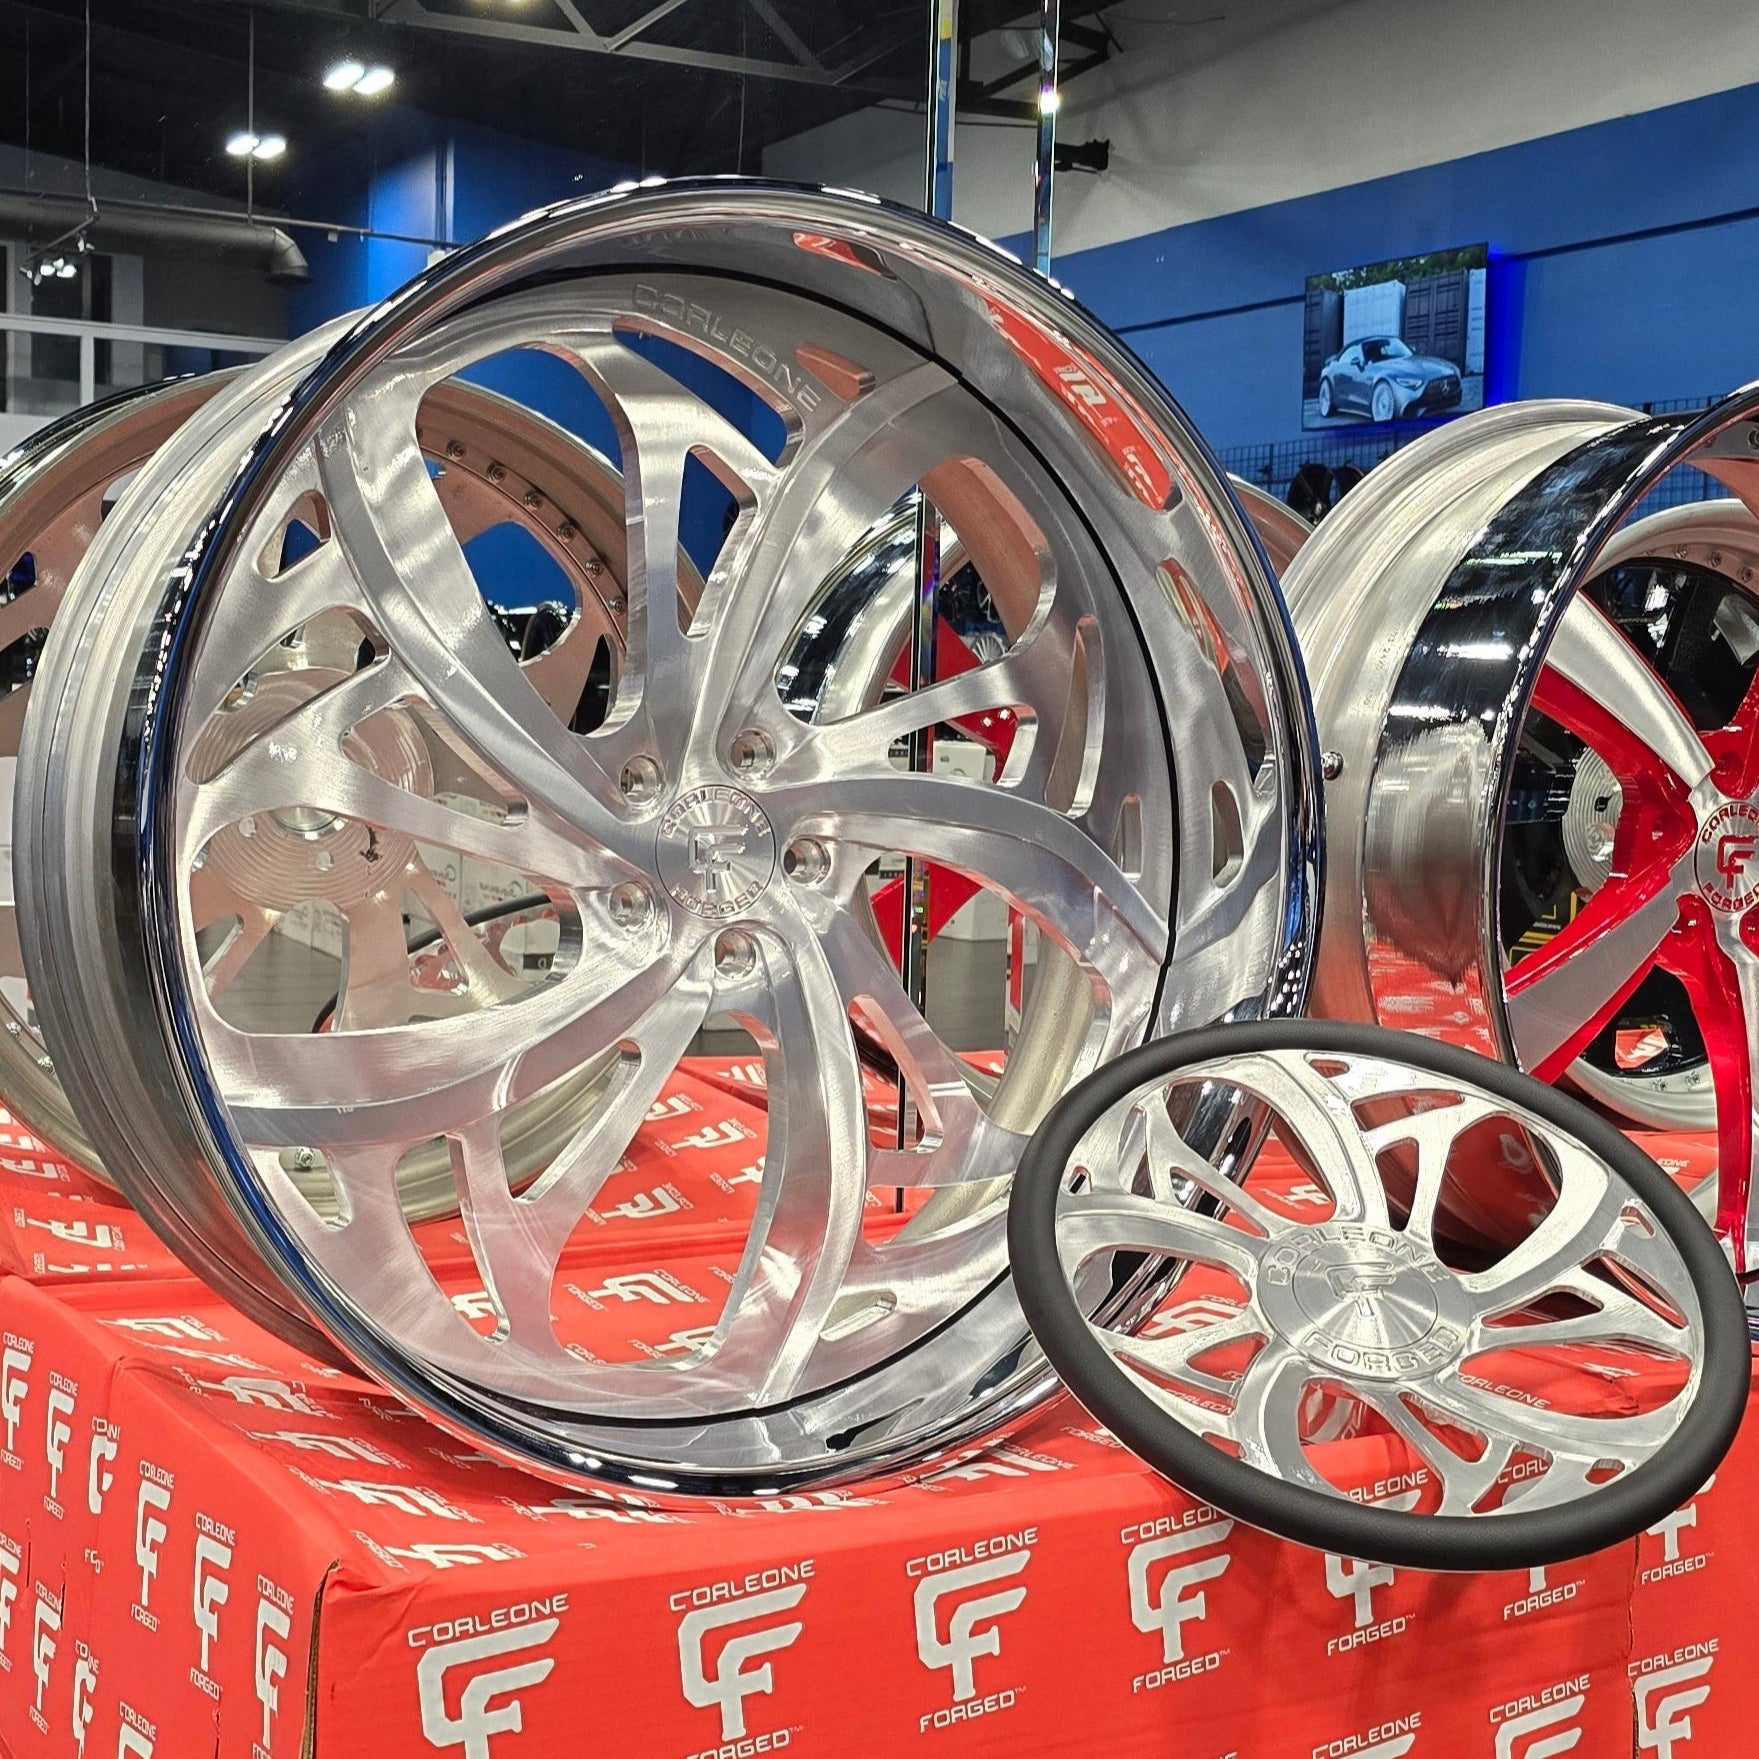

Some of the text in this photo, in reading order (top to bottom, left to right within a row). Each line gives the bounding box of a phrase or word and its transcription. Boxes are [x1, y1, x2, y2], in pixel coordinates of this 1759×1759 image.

[631, 283, 822, 413] CORLEONE
[1701, 804, 1759, 845] CORLEO
[1267, 1226, 1450, 1286] CORLEONE
[1303, 1325, 1460, 1372] FORGED
[1349, 1468, 1429, 1503] RLEONE
[196, 1512, 236, 1546] CORLEONE
[1121, 1506, 1217, 1544] CORLEO
[906, 1527, 1039, 1577] CORLEONE
[257, 1574, 294, 1615] CORLEONE
[669, 1559, 816, 1613] CORLEONE
[407, 1593, 570, 1649] CORLEONE
[1627, 1638, 1720, 1677] CORLEONE
[120, 1701, 156, 1741] CORLEONE
[1489, 1673, 1591, 1724] CORLEONE
[1312, 1711, 1422, 1759] CORLEONE
